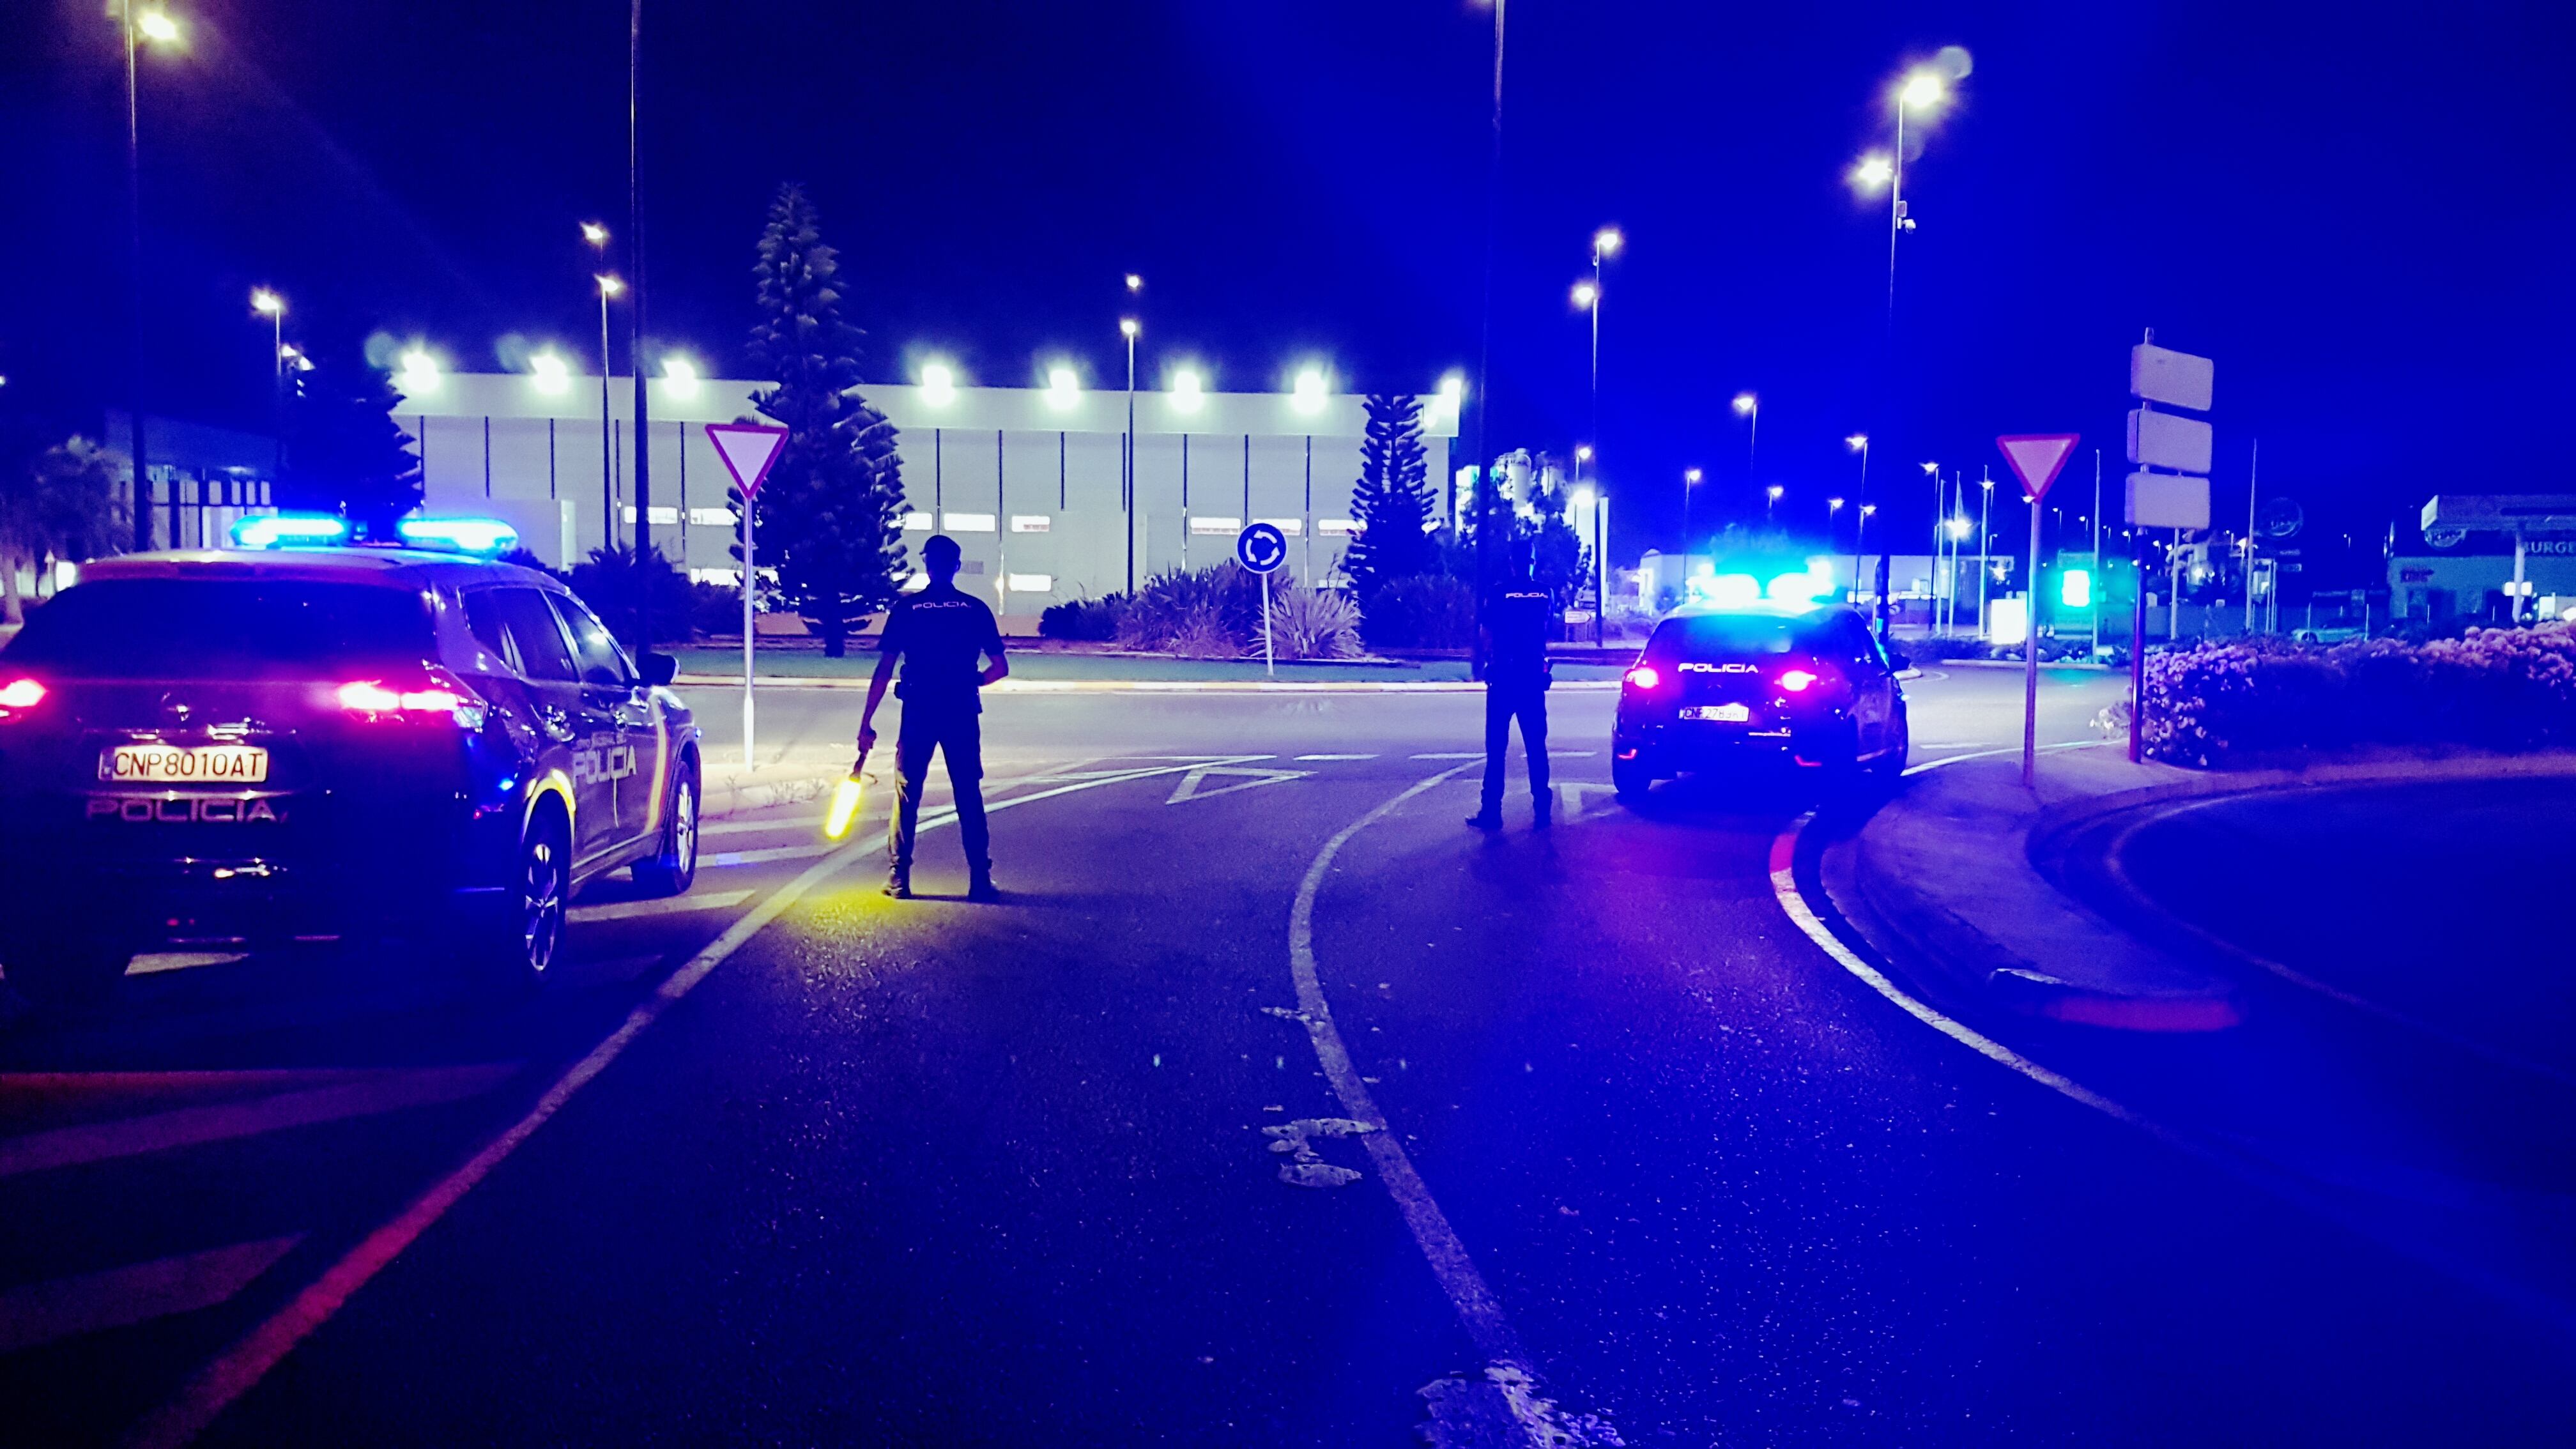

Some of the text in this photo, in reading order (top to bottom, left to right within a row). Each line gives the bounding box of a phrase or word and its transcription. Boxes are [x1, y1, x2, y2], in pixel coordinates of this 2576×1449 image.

[912, 601, 969, 610] POLICIA
[1678, 663, 1759, 673] POLICIA
[572, 745, 637, 790] POLICIA
[86, 799, 277, 824] POLICIA
